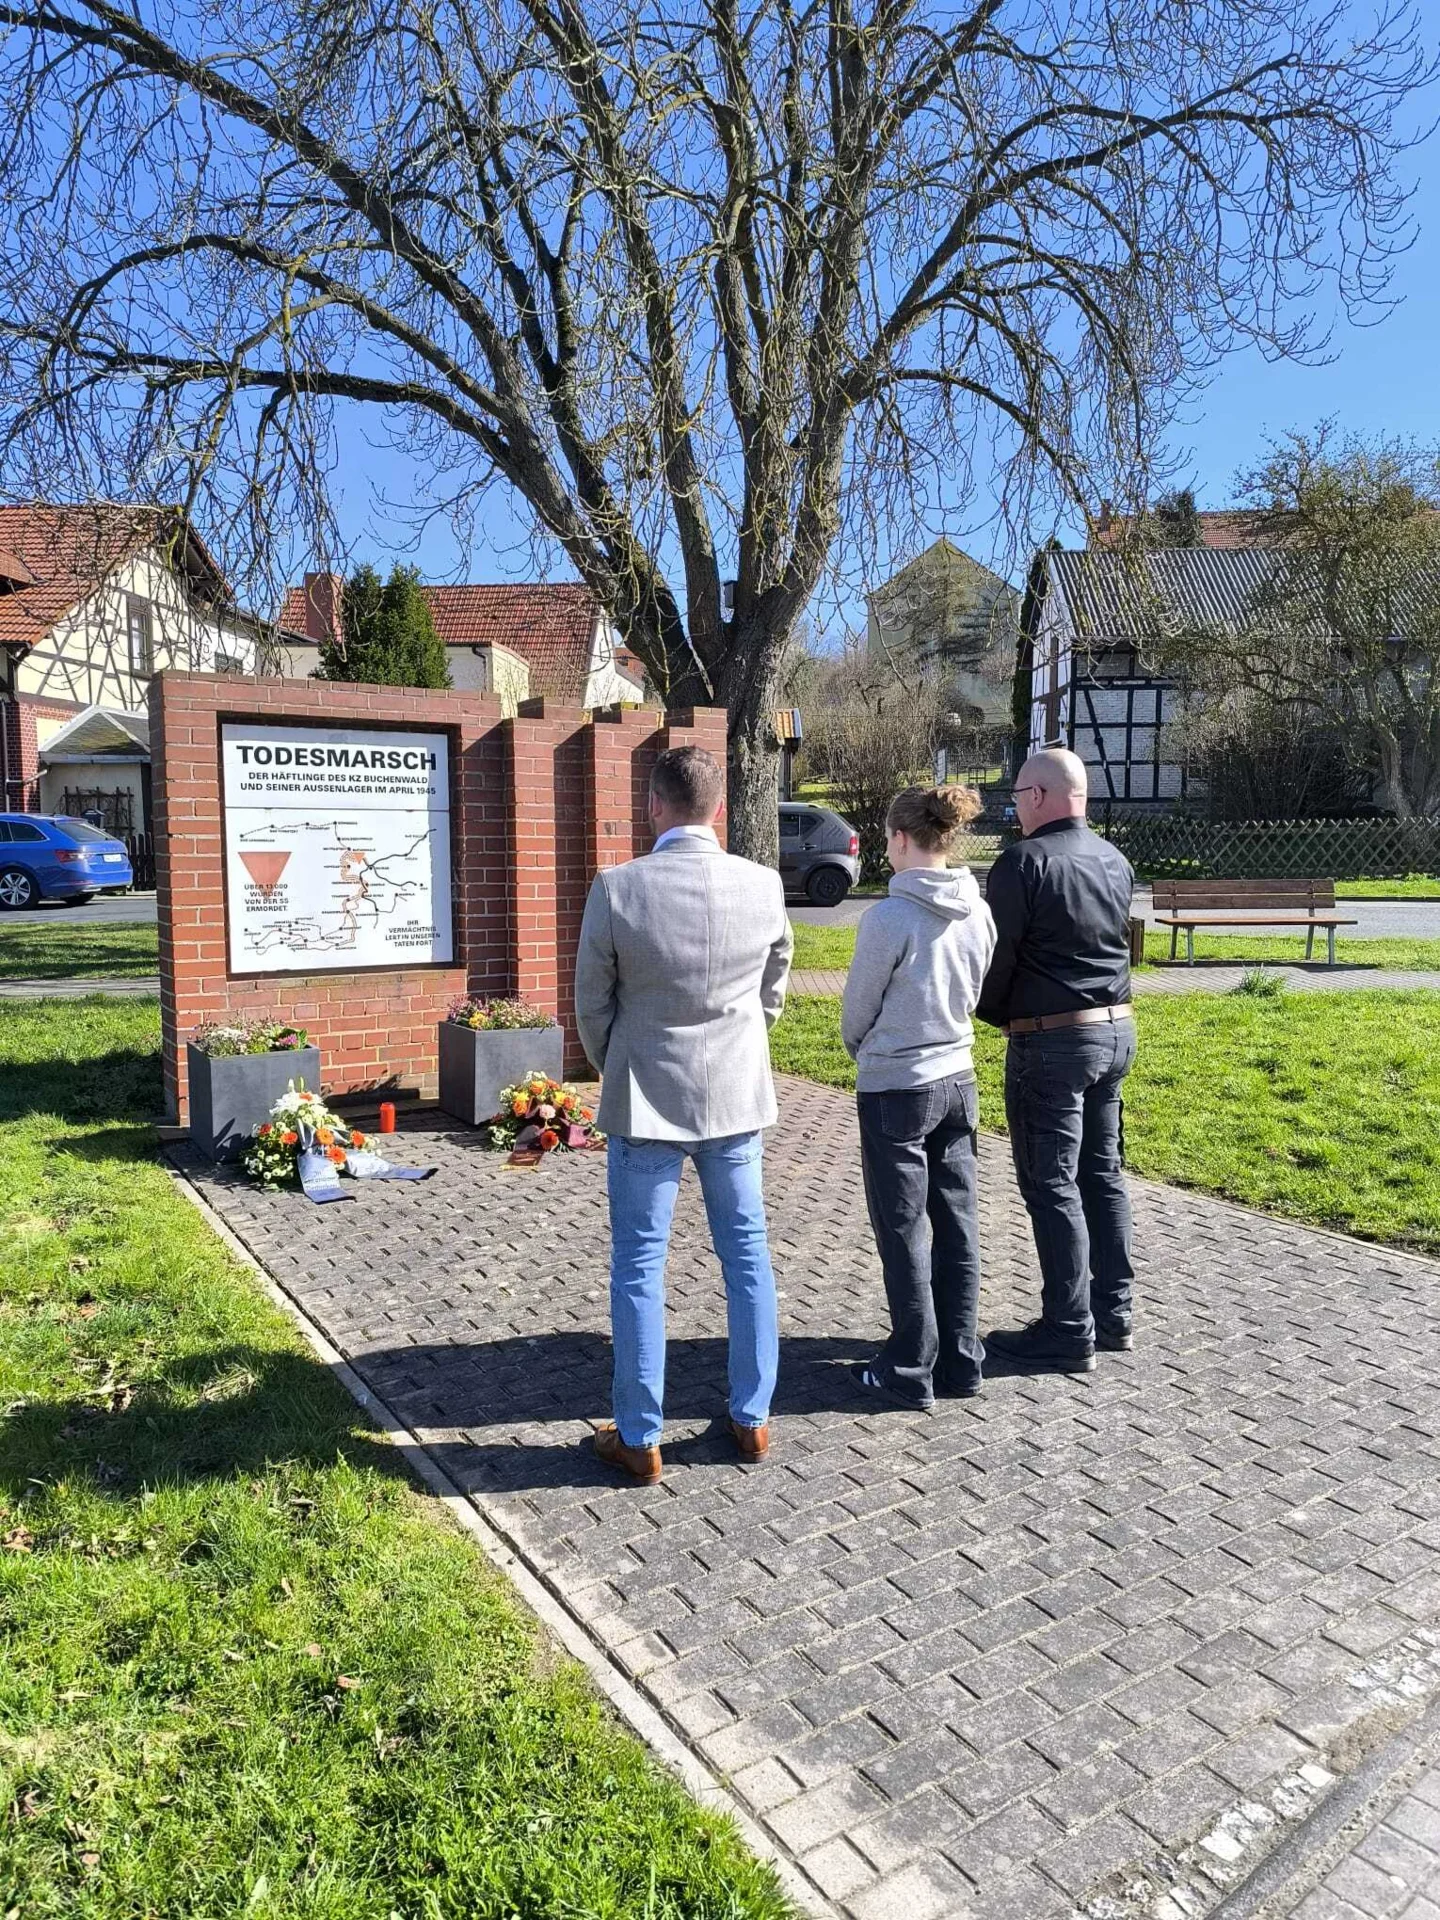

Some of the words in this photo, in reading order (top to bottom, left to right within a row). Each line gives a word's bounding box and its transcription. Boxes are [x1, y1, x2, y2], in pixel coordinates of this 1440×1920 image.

[236, 745, 436, 770] TODESMARSCH
[248, 772, 269, 780] DER
[271, 771, 325, 781] HÄFTLINGE
[328, 774, 346, 782] DES
[364, 775, 428, 784] BUCHENWALD
[240, 782, 263, 791] UND
[265, 783, 301, 791] SEINER
[303, 784, 373, 793] AUSSENLAGER
[389, 786, 414, 794] APRIL
[416, 787, 436, 795] 1945
